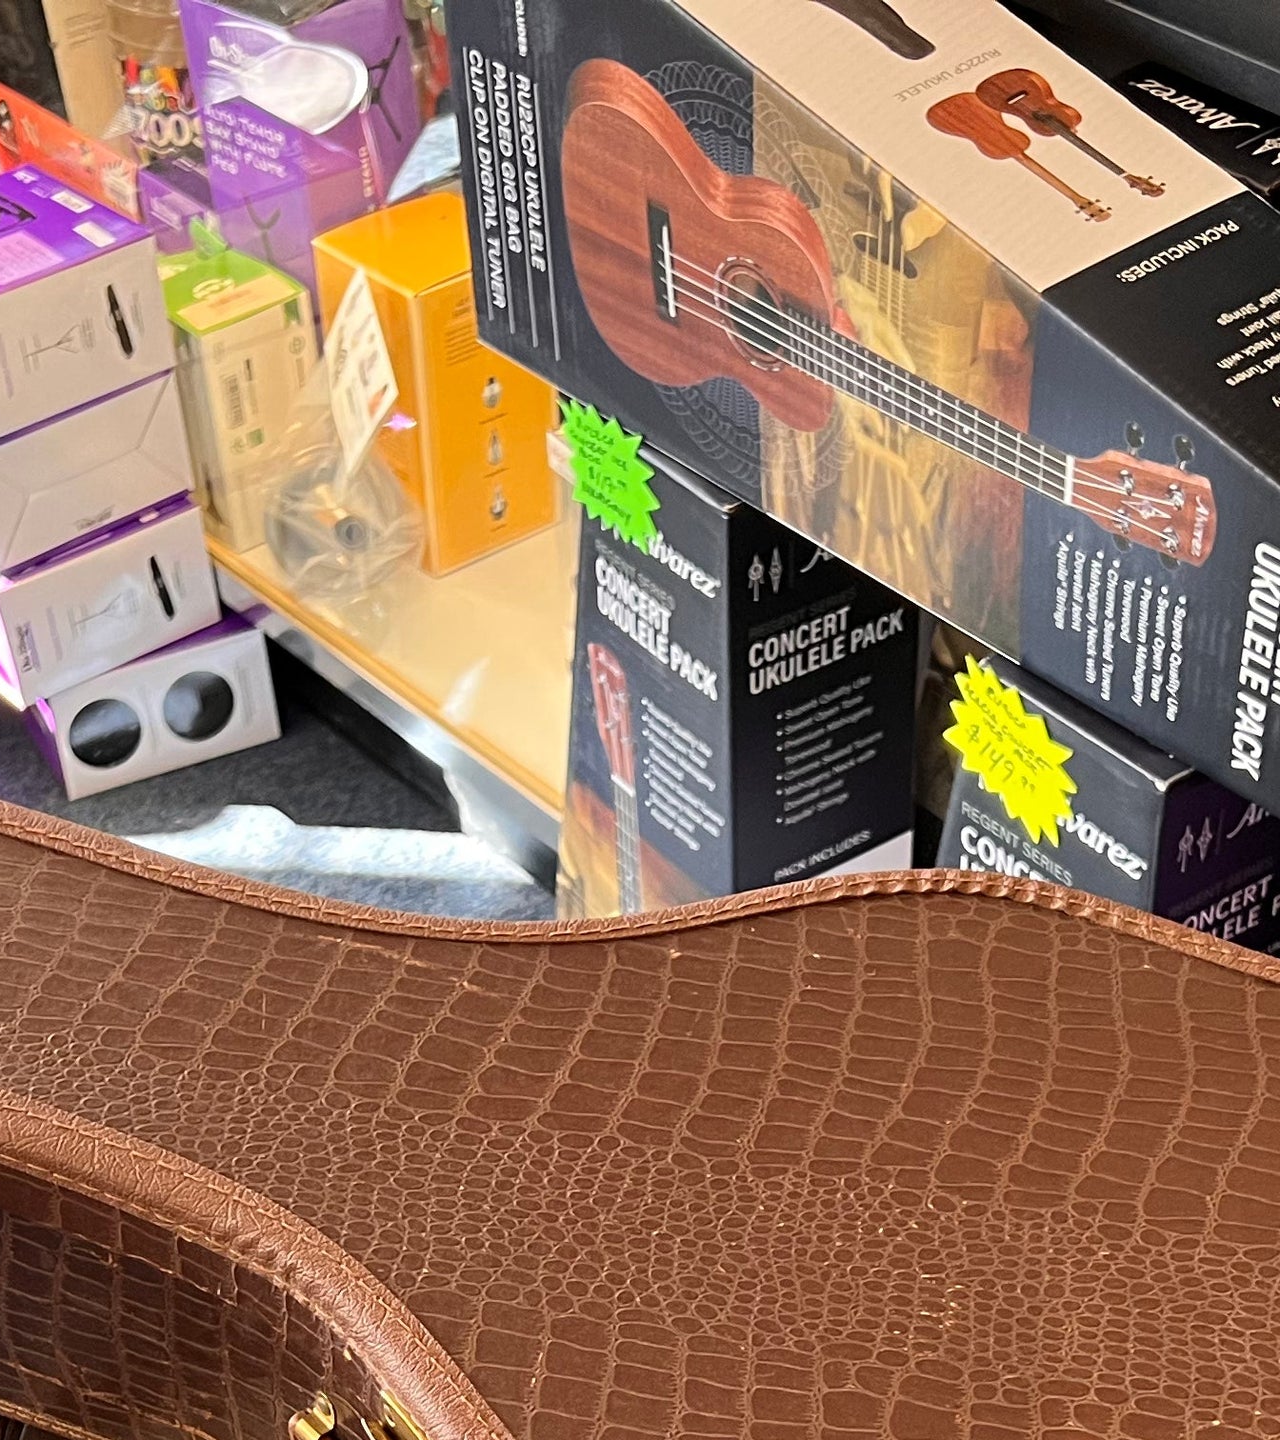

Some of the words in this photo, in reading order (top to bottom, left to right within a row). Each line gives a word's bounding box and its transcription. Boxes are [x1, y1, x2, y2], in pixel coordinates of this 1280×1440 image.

[469, 49, 486, 103] CLIP
[474, 107, 491, 144] ON
[492, 61, 514, 158] PADDED
[516, 74, 537, 168] RU22CP
[1131, 78, 1260, 131] Alvarez
[478, 147, 499, 230] DIGITAL
[501, 161, 518, 203] GIG
[505, 206, 523, 254] BAG
[524, 170, 547, 272] UKULELE
[1192, 219, 1240, 246] PACK
[487, 237, 507, 309] TUNER
[1116, 237, 1196, 283] INCLUDES:
[1217, 303, 1259, 326] Strings
[1239, 318, 1270, 337] Joint
[1216, 352, 1244, 370] with
[1242, 337, 1275, 357] Neck
[1225, 364, 1268, 387] Tuners
[595, 555, 672, 636] CONCERT
[596, 586, 670, 666] UKULELE
[670, 641, 718, 702] PACK
[748, 605, 852, 669] CONCERT
[749, 635, 847, 696] UKULELE
[850, 608, 904, 654] PACK
[1230, 691, 1268, 782] PACK
[961, 800, 1020, 849] REGENT
[1022, 840, 1074, 888] SERIES
[1183, 873, 1274, 931] ONCERT
